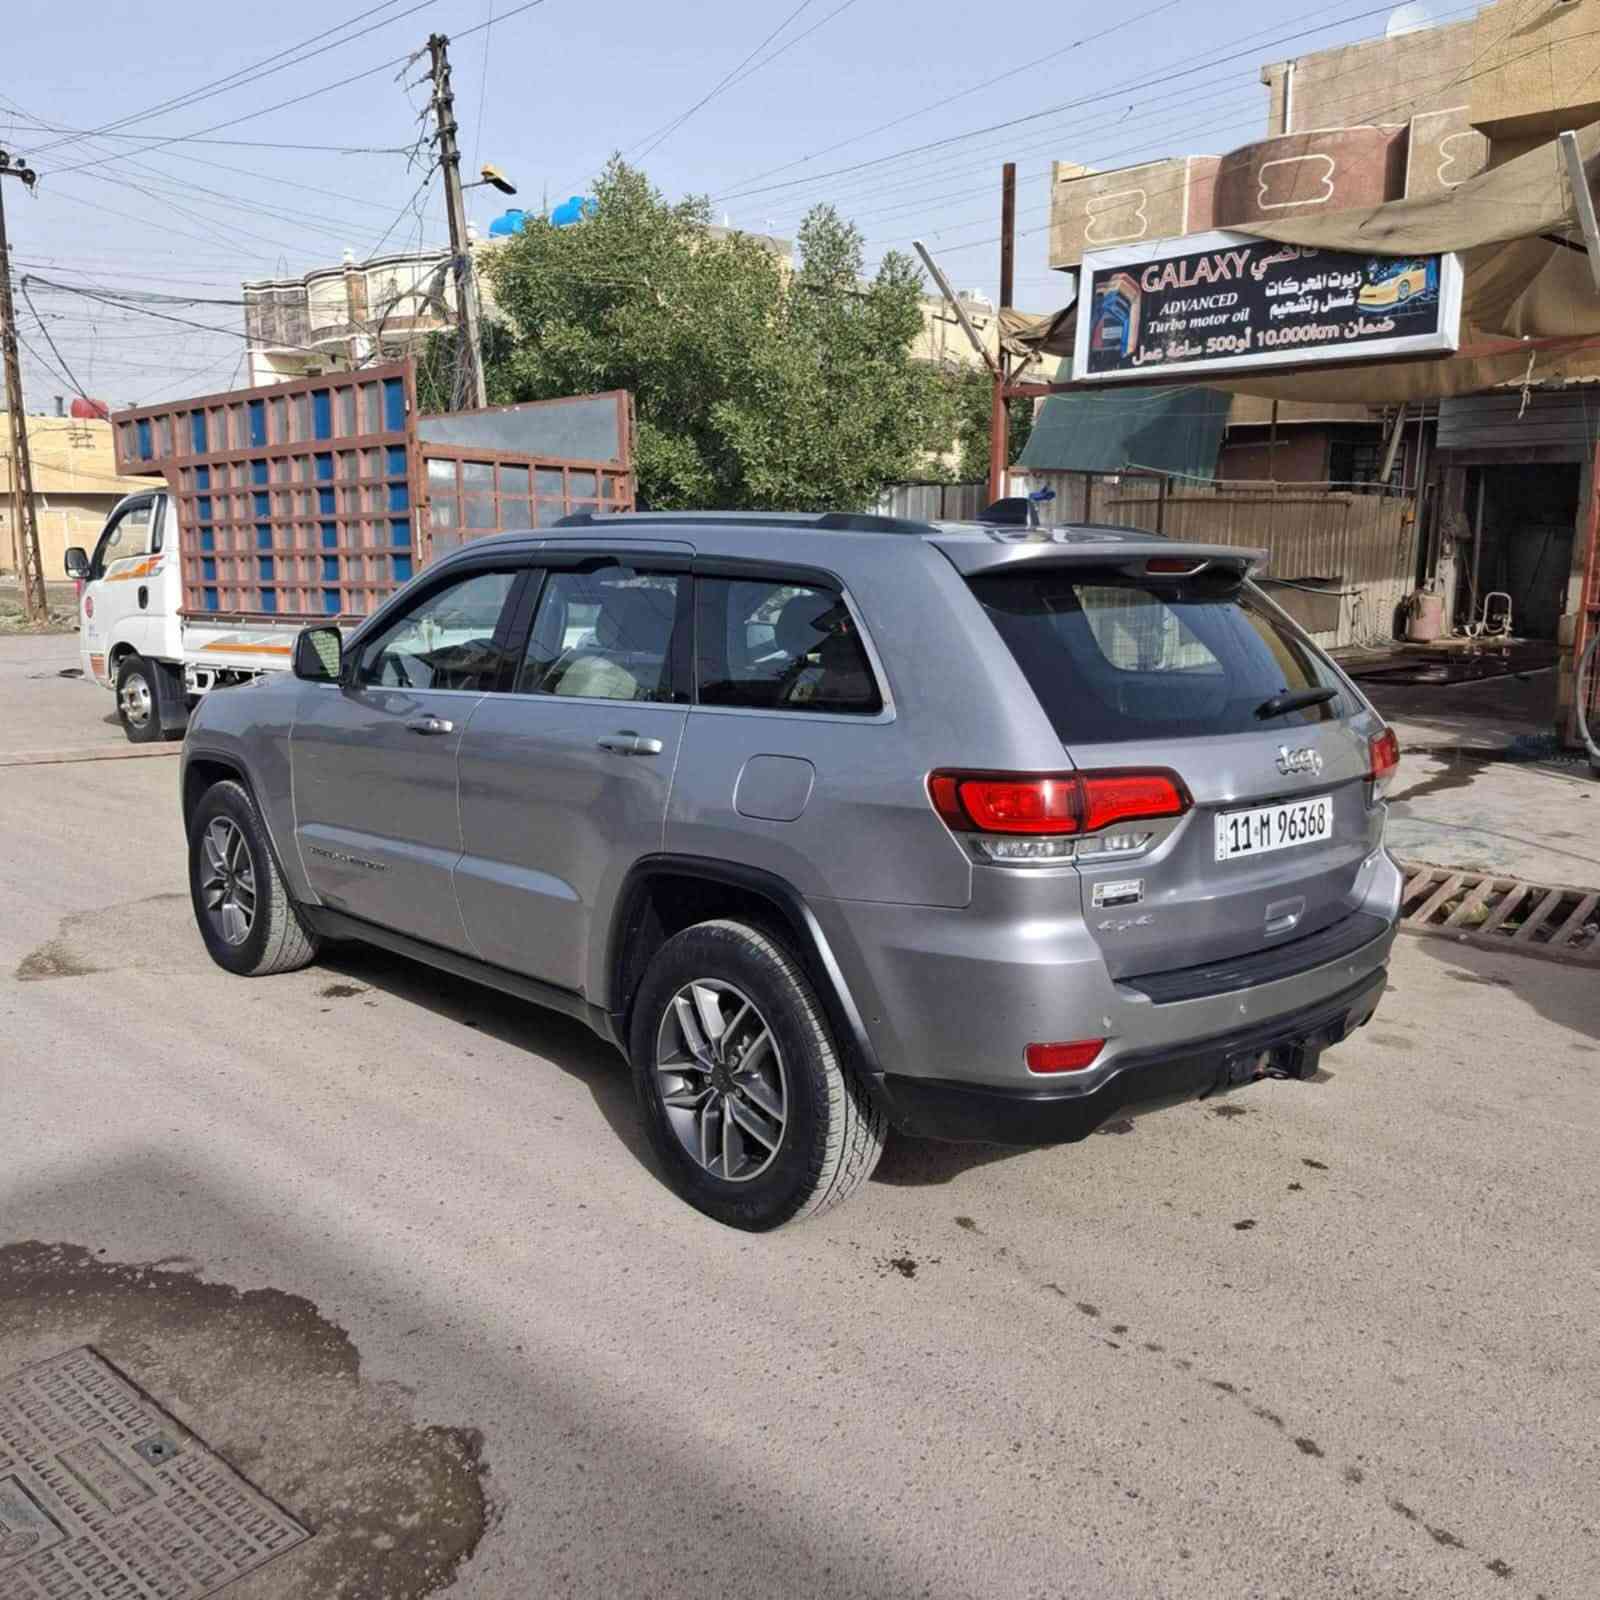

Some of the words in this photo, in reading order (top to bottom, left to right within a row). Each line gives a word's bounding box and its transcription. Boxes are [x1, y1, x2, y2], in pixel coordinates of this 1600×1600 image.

[1141, 249, 1251, 292] GALAXY
[1328, 270, 1362, 290] زيوت
[1265, 274, 1327, 296] المحركات
[1159, 292, 1239, 316] ADVANCED
[1270, 295, 1319, 320] وتشحيم
[1320, 290, 1355, 313] غسل
[1148, 318, 1187, 334] Turbo
[1189, 313, 1230, 328] motor
[1232, 307, 1250, 322] oil
[1344, 316, 1395, 338] ضمان
[1132, 345, 1163, 366] عمل
[1276, 745, 1323, 776] Jeep
[1230, 815, 1252, 852] 11
[1260, 813, 1271, 847] M
[1278, 803, 1325, 843] 96368
